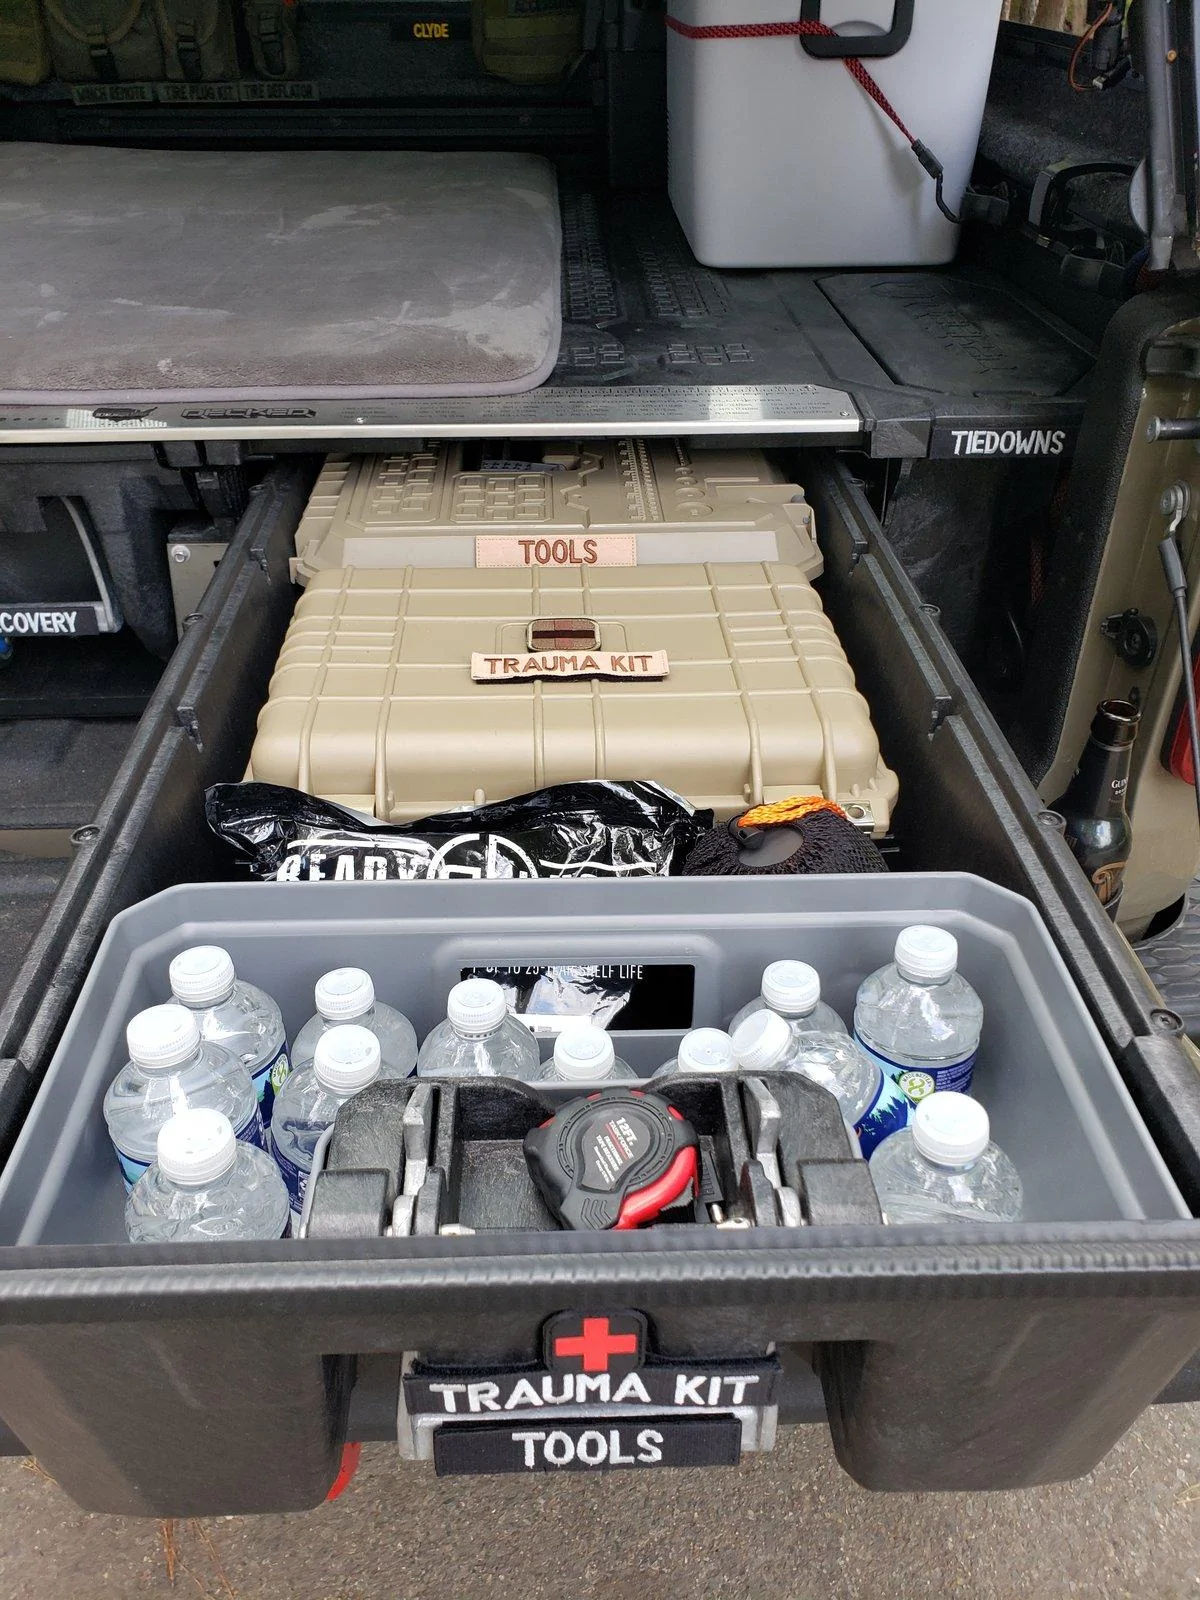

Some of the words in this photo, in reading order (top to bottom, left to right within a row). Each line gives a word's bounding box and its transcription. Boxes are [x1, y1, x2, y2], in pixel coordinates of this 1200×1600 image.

[412, 22, 450, 39] CLYDE
[109, 85, 147, 100] REMOTE
[165, 84, 186, 100] TIRE
[188, 85, 216, 99] PLUG
[217, 84, 234, 99] KIT
[244, 84, 265, 98] TIRE
[267, 83, 313, 98] DEFLATOR
[951, 430, 1066, 455] TIEDOWNS
[518, 539, 598, 564] TOOLS
[0, 611, 77, 633] COVERY
[484, 655, 600, 674] TRAUMA
[610, 655, 653, 672] KIT
[620, 964, 644, 980] LIFE
[429, 1372, 652, 1413] TRAUMA
[674, 1373, 760, 1406] KIT
[511, 1428, 664, 1469] TOOLS
